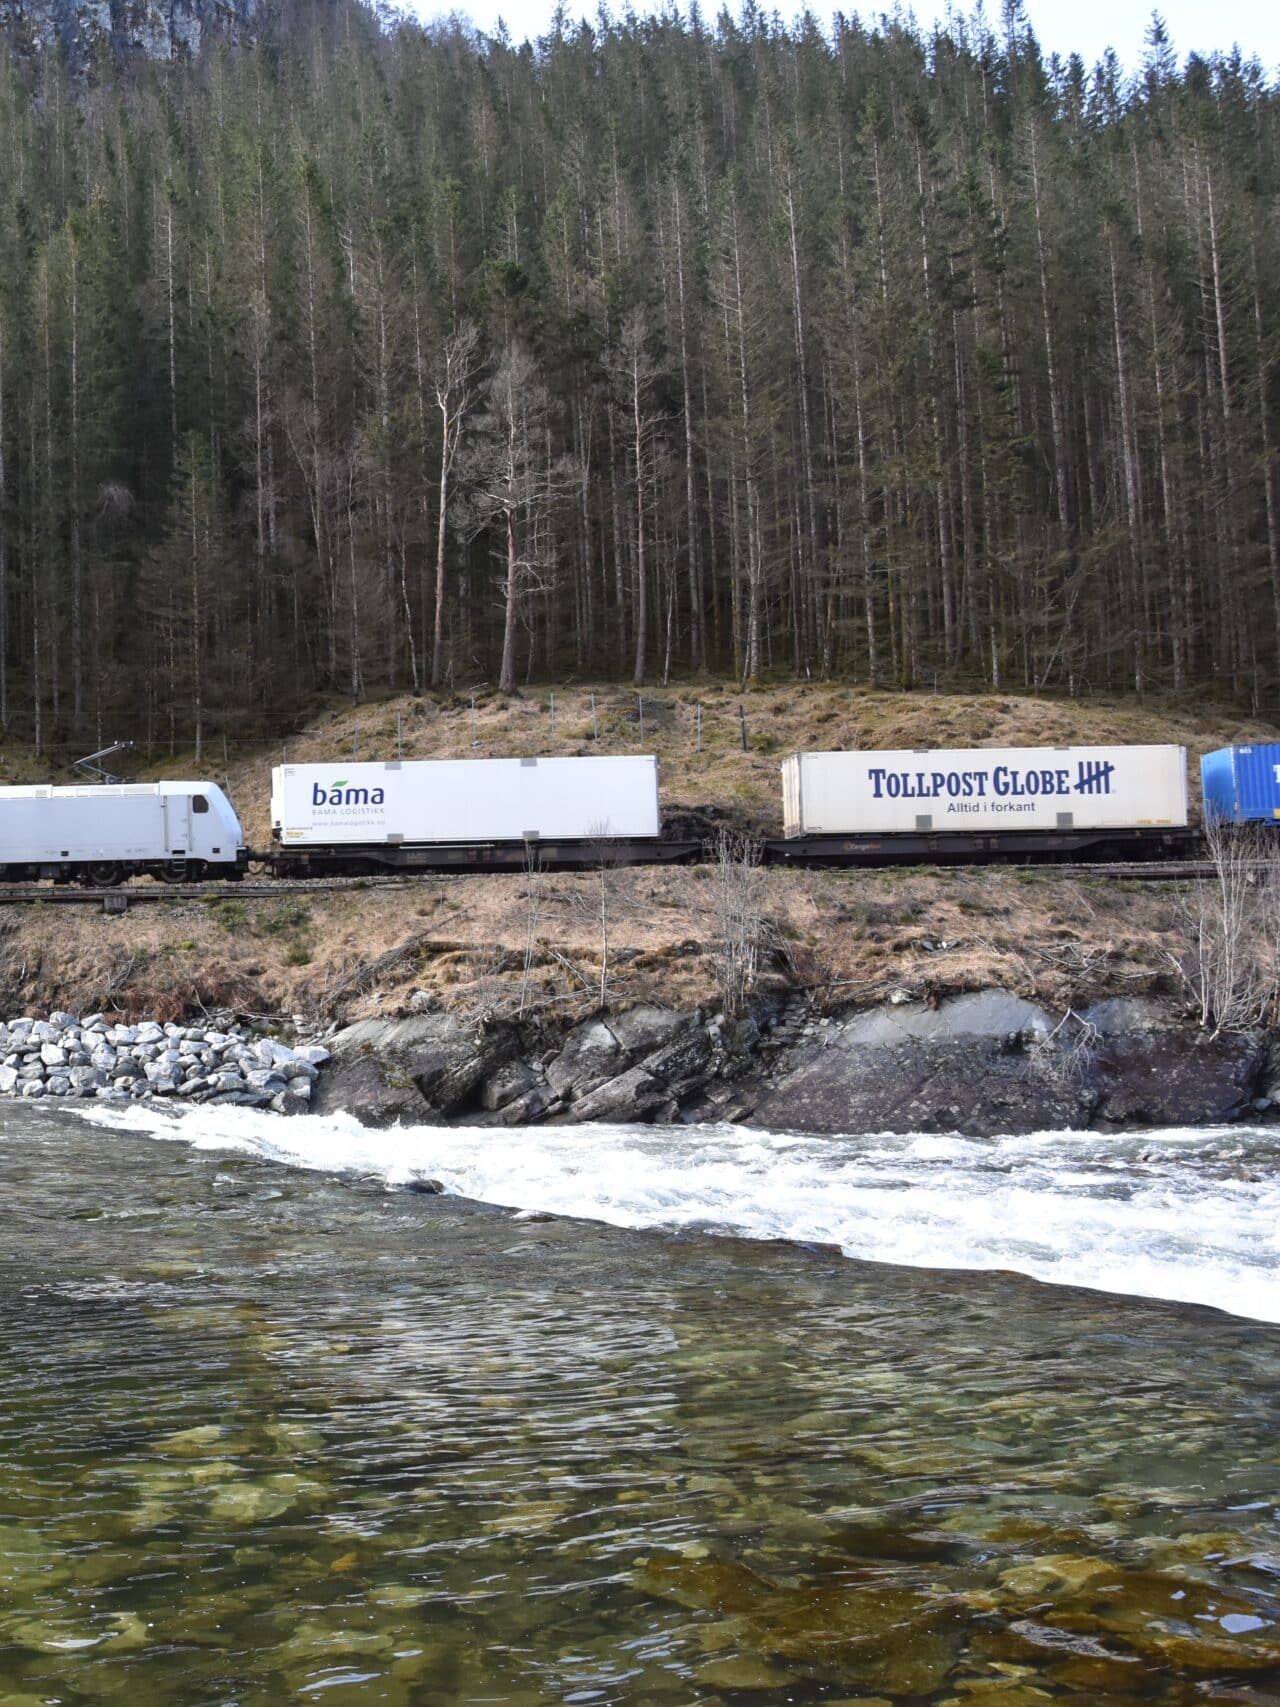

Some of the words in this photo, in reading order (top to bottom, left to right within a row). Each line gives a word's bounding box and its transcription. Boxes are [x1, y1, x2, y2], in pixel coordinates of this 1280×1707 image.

[868, 768, 988, 798] TOLLPOST
[993, 765, 1070, 796] GLOBE
[312, 781, 385, 806] bama
[312, 808, 337, 816] BAMA
[340, 807, 385, 815] LOGISTIKK
[947, 802, 980, 813] Alltid
[991, 801, 1036, 812] forkant
